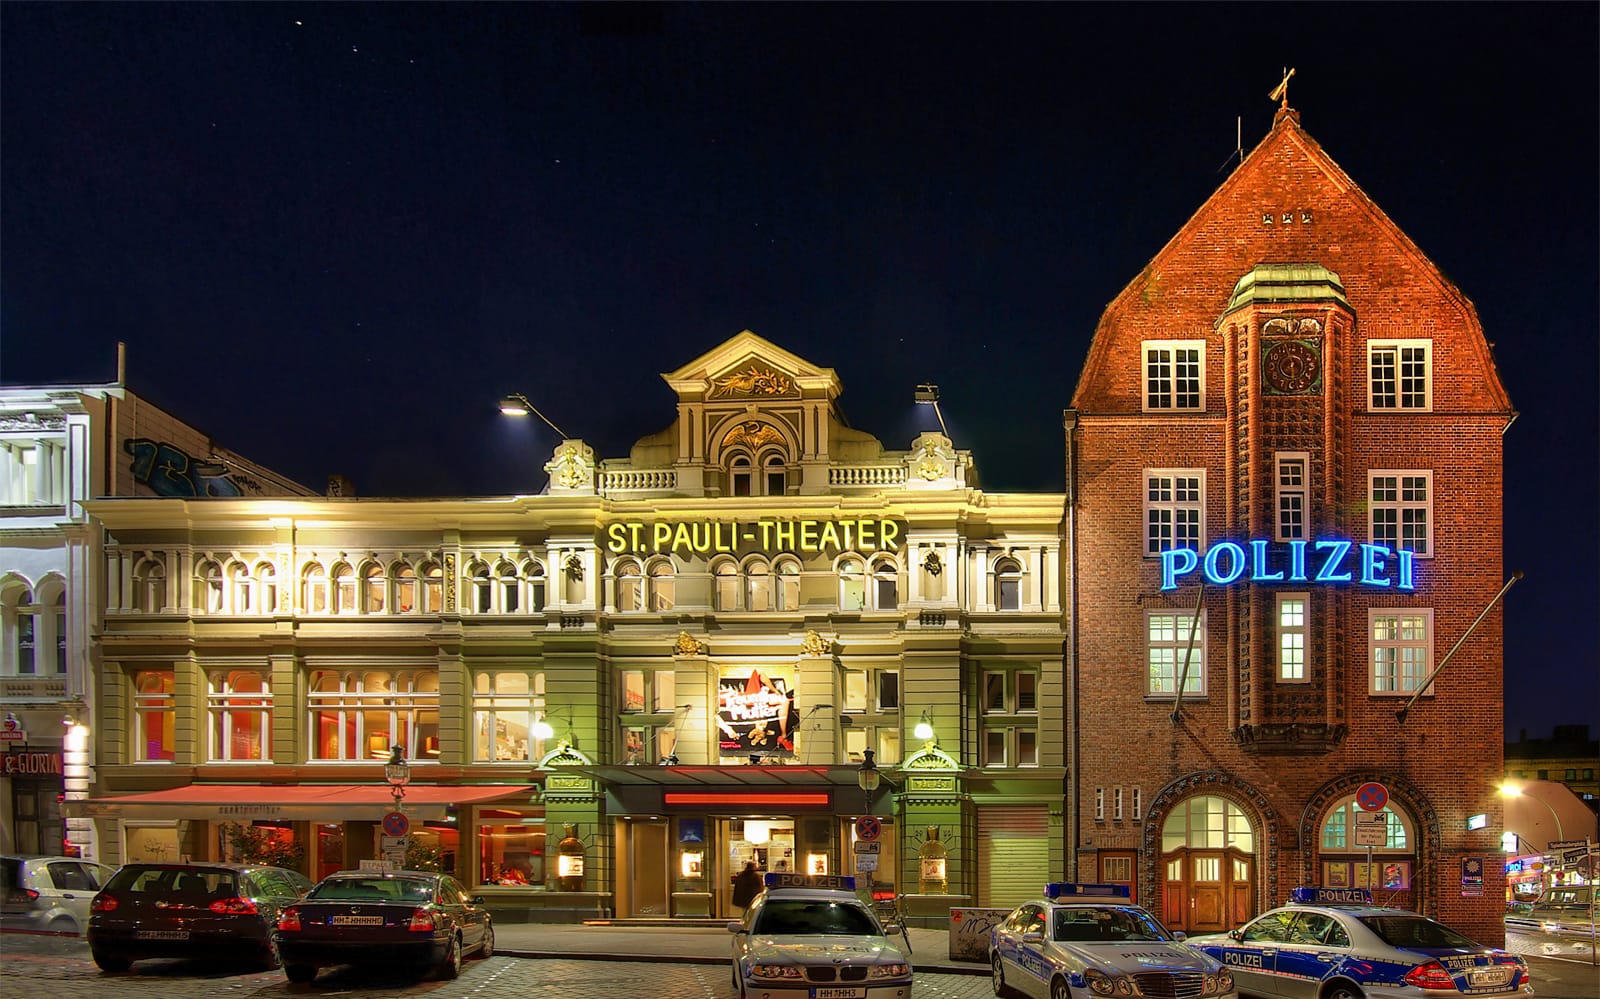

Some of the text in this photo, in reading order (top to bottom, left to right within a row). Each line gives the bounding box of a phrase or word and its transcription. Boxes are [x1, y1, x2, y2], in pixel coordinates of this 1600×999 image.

[1160, 539, 1415, 592] POLIZEI
[18, 753, 59, 774] GLORIA
[780, 875, 842, 888] POLIZEI
[1318, 890, 1365, 903] POLIZEI
[1225, 952, 1263, 968] POLIZEI
[1448, 959, 1476, 968] POLIZEI
[820, 990, 833, 998] HH
